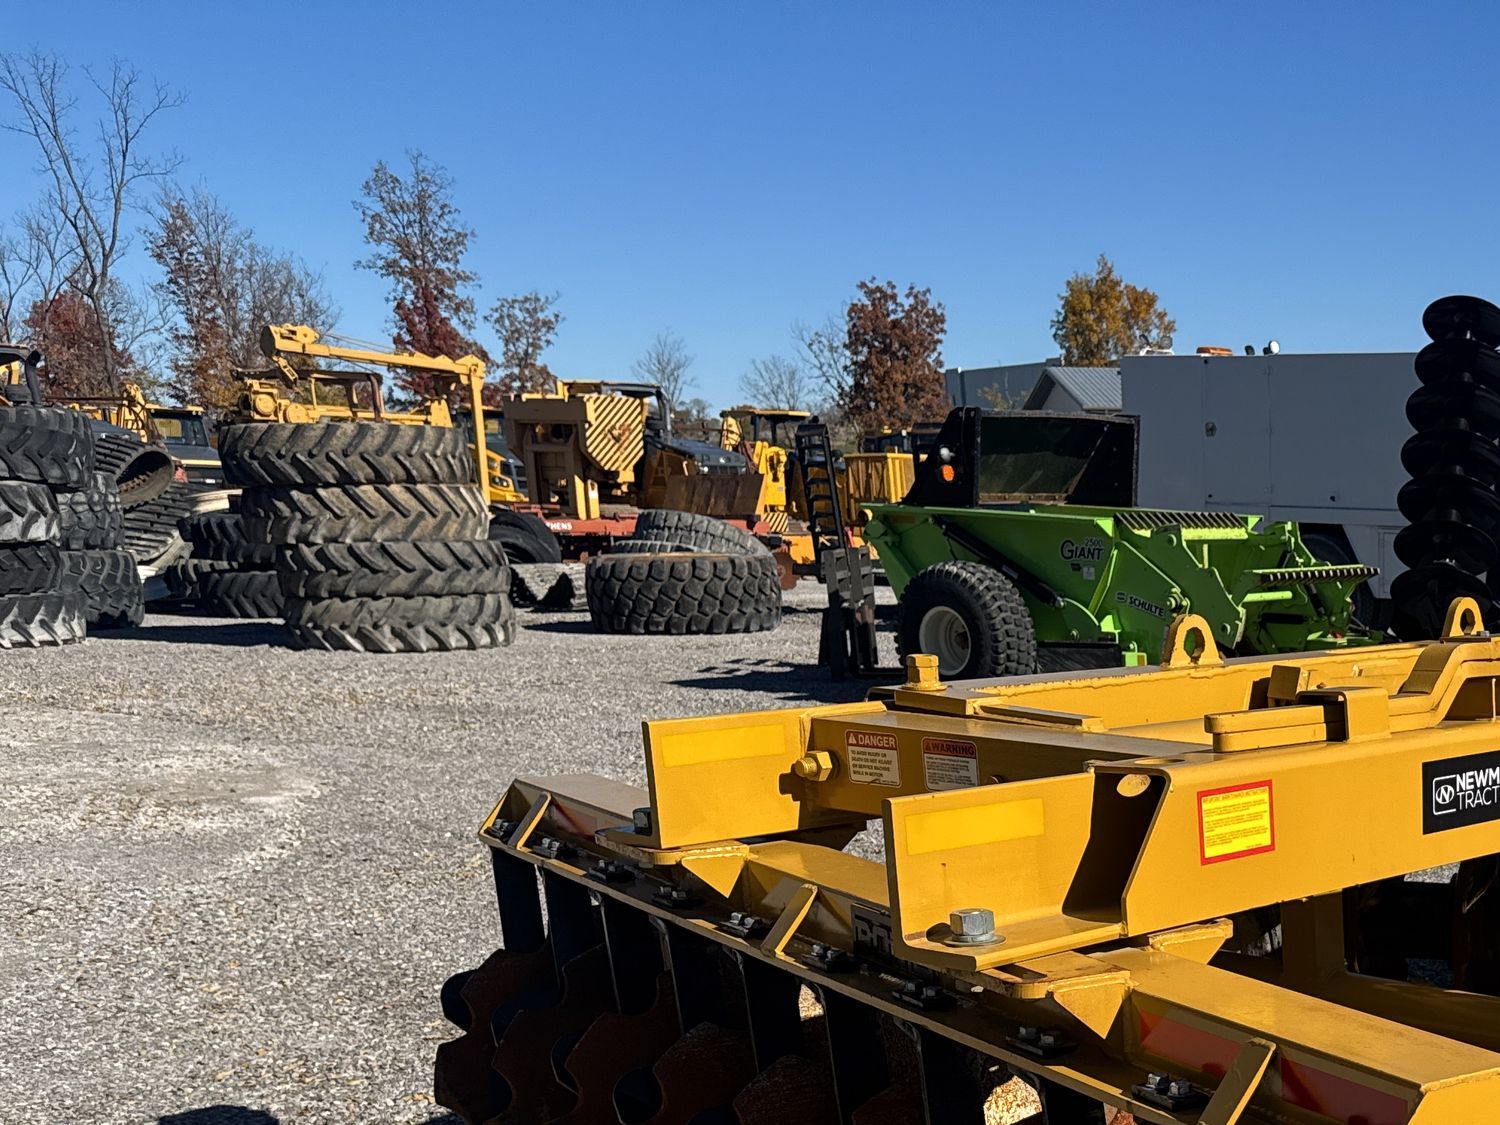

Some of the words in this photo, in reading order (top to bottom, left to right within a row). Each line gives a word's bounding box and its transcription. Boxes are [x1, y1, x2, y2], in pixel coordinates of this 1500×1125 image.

[1060, 540, 1104, 560] GIANT
[1128, 596, 1165, 617] SCHULTE
[858, 734, 896, 748] DANGER
[930, 742, 975, 756] WARNING
